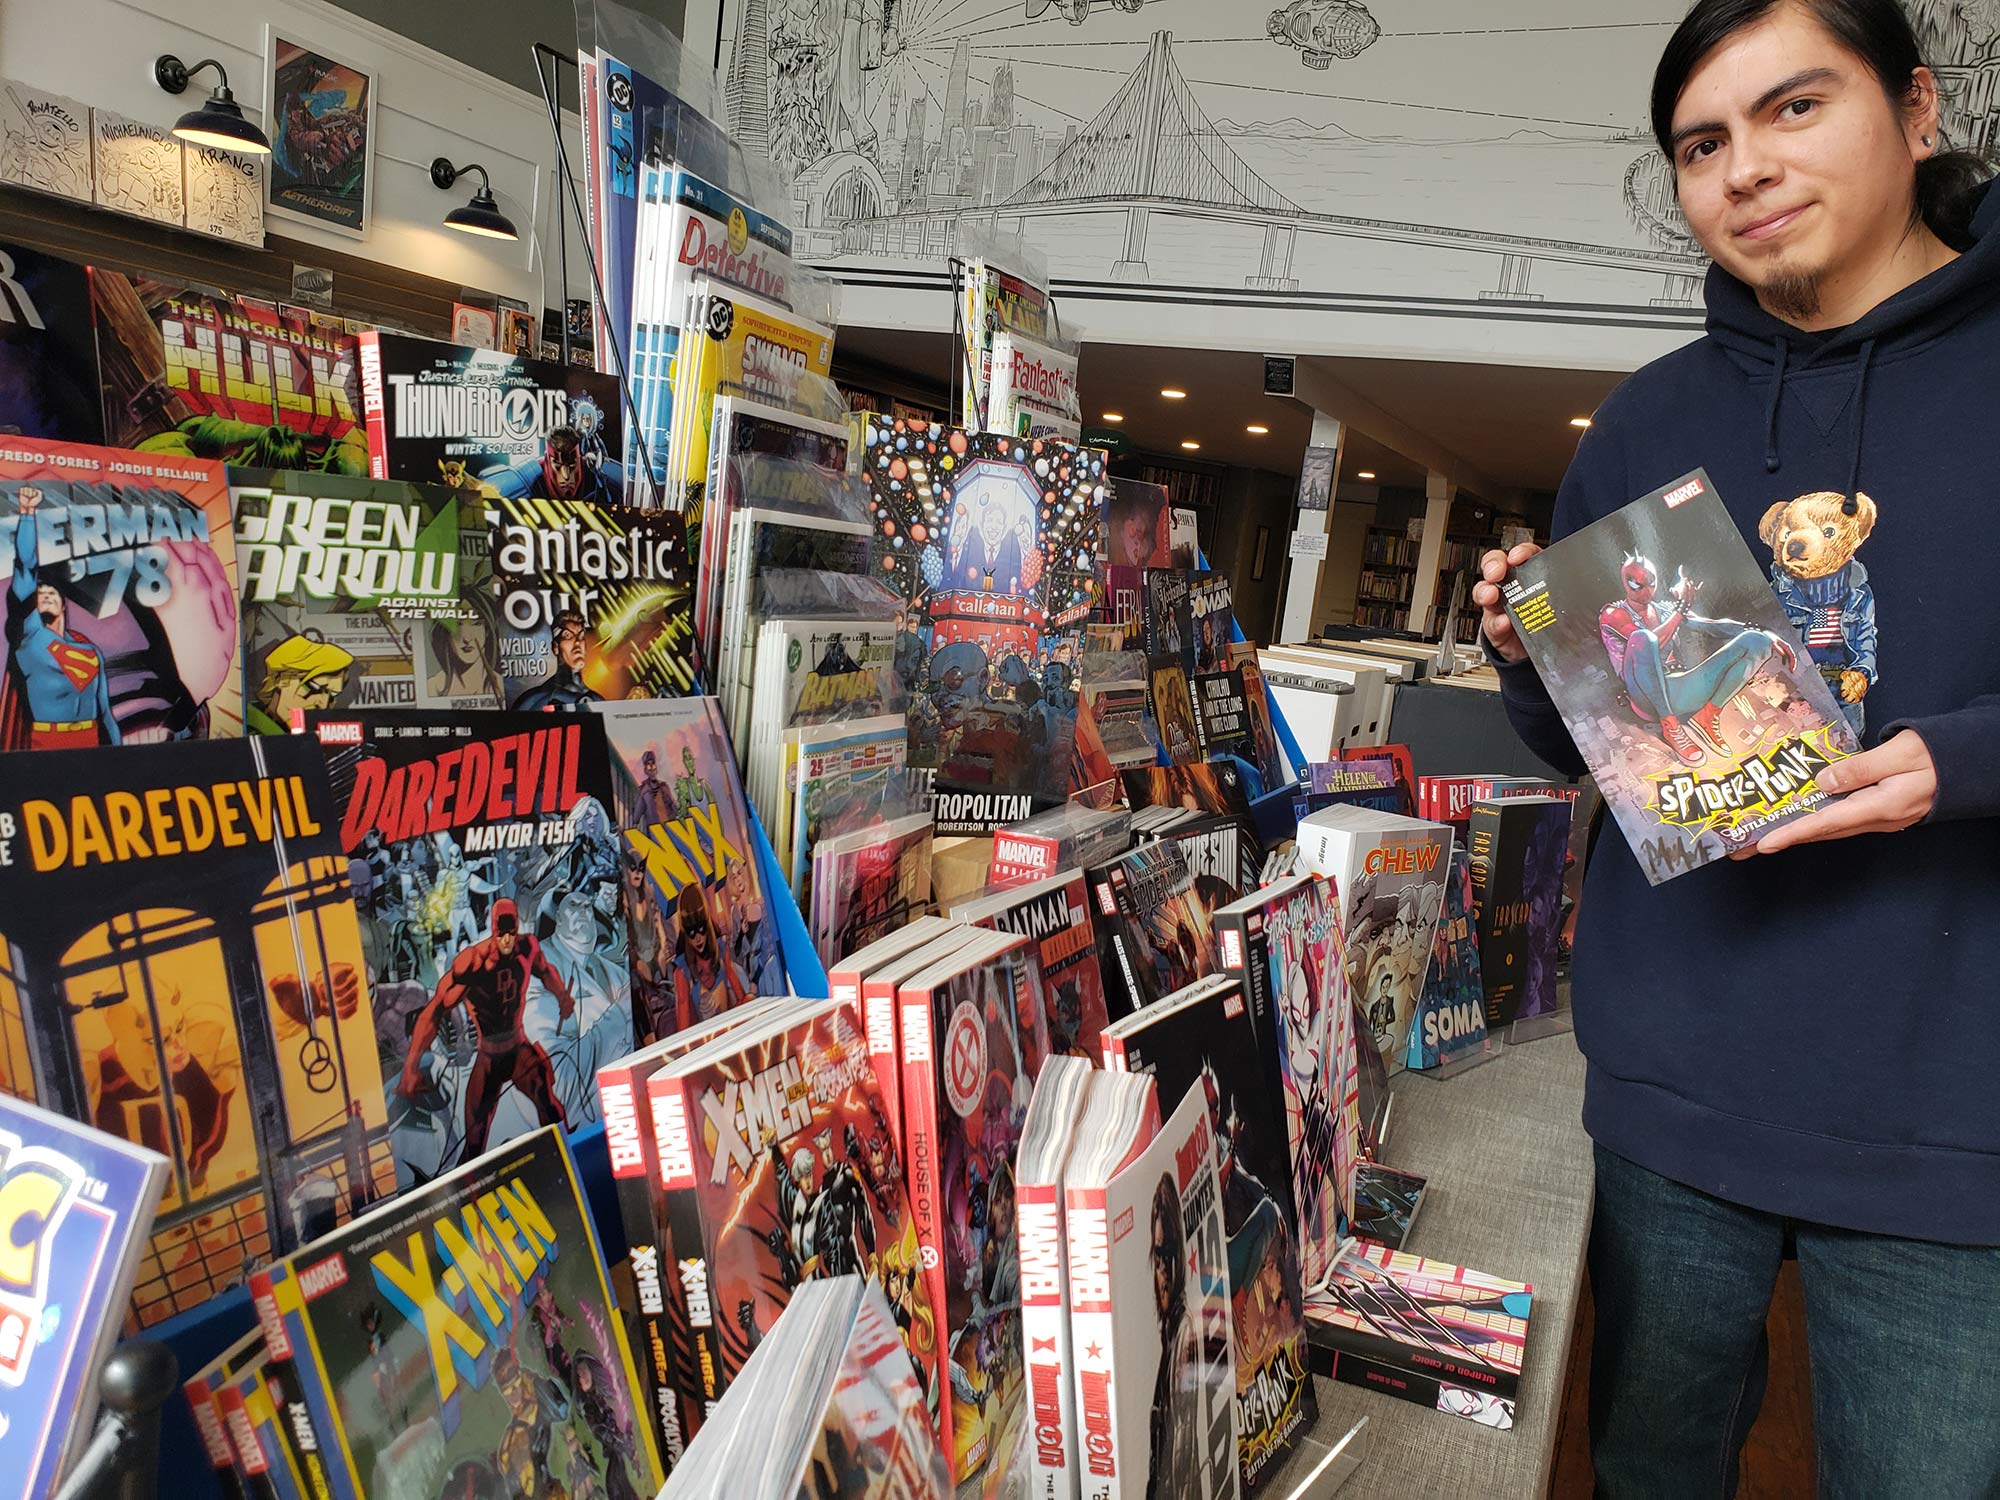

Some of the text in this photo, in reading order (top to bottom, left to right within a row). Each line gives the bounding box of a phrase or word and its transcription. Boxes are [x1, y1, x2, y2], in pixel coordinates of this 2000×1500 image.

[313, 67, 338, 81] MAGIC
[27, 99, 79, 133] DONATELLO
[199, 148, 254, 177] KRANG
[208, 224, 223, 236] $75
[678, 216, 785, 296] Detective
[167, 299, 343, 356] THE INCREDIBLE
[161, 319, 356, 422] HULK
[360, 344, 380, 414] MARVEL
[1011, 350, 1070, 401] Fantastic
[388, 374, 569, 441] THUNDERBOLTS
[48, 455, 208, 482] TORRES JORDIE BELLAIRE
[446, 443, 533, 455] WINTER SOLDIERS
[235, 487, 420, 549] GREEN
[1170, 507, 1195, 530] SPAWN
[1663, 478, 1703, 509] MARVEL
[68, 546, 172, 620] '78
[240, 545, 456, 601] ARROW
[345, 617, 360, 628] THE
[378, 598, 460, 608] AGAINST
[388, 608, 479, 620] THE WALL
[959, 599, 1016, 617] callahan
[1116, 589, 1144, 624] FERAL
[320, 722, 362, 742] MARVEL
[340, 724, 589, 853] DAREDEVIL
[810, 759, 823, 777] 25
[1332, 768, 1377, 786] HELEN OF
[1660, 744, 1826, 821] SPIDER-PUNK
[22, 776, 320, 872] DAREDEVIL
[465, 818, 577, 852] MAYOR FISK
[938, 822, 984, 832] ROBERTSON
[1729, 801, 1803, 838] BATTLE OF THE
[624, 803, 745, 901] NYX
[998, 840, 1046, 867] MARVEL
[1364, 845, 1440, 876] CHEW
[1469, 830, 1492, 889] FARSCAPE
[996, 889, 1070, 939] BATMAN
[867, 997, 893, 1056] MARVEL
[902, 1004, 929, 1064] MARVEL
[1424, 999, 1485, 1046] SOMA
[601, 1083, 641, 1172] MARVEL
[651, 1094, 694, 1183] MARVEL
[701, 1055, 814, 1186] X-MEN
[913, 1132, 932, 1240] HOUSE OF X
[299, 1255, 346, 1294] MARVEL
[1018, 1203, 1060, 1300] MARVEL
[1068, 1209, 1112, 1307] MARVEL
[370, 1176, 557, 1402] X-MEN
[630, 1245, 663, 1315] X-MEN
[653, 1337, 668, 1375] AGE
[258, 1294, 290, 1361] MARVEL
[679, 1257, 712, 1328] X-MEN
[702, 1351, 714, 1387] AGE
[1410, 1353, 1496, 1386] WEAPON OF CHOICE
[193, 1399, 232, 1467] MARVEL
[227, 1407, 268, 1475] MARVEL
[290, 1401, 317, 1451] X-MEN
[966, 1433, 988, 1467] MARVEL
[1246, 1454, 1267, 1480] BATTLE
[1274, 1431, 1285, 1449] THE
